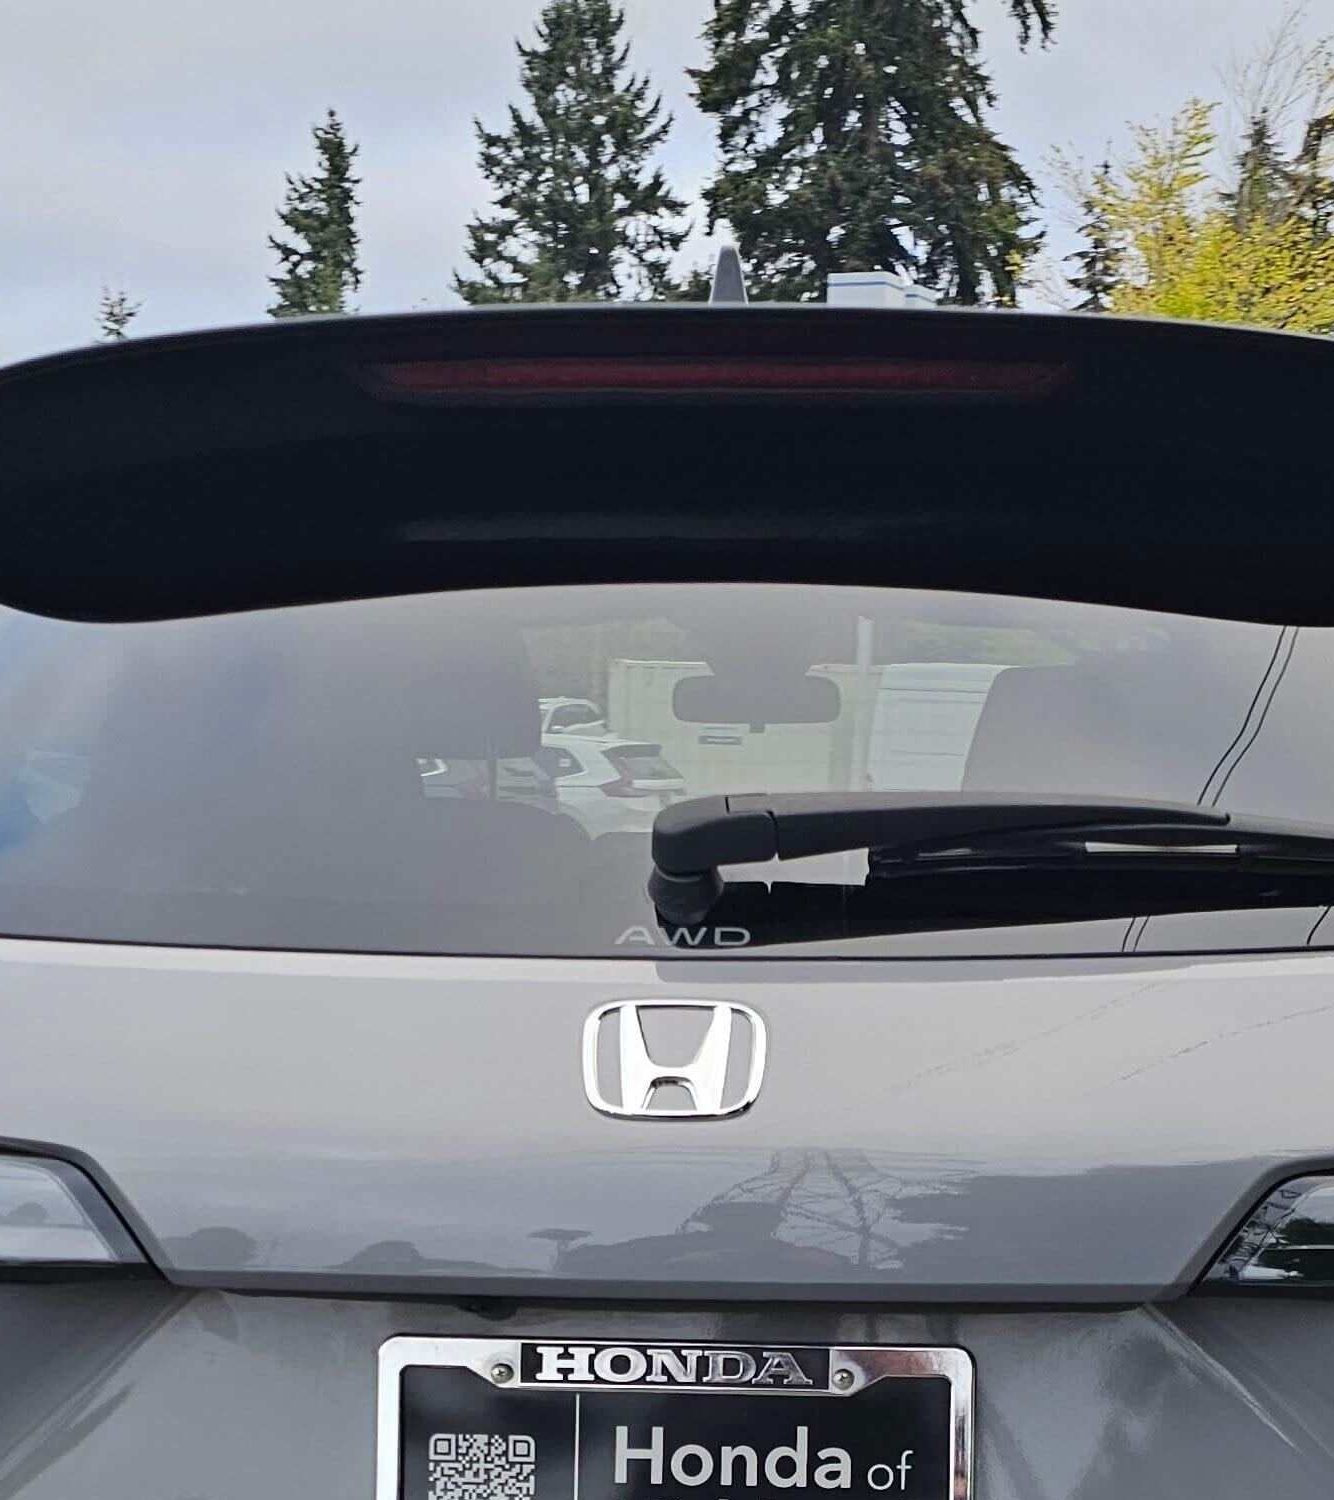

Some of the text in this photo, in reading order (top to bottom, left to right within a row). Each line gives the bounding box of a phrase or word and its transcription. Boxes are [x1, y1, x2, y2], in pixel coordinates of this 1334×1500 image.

[614, 925, 752, 946] AWD
[534, 1345, 814, 1386] HONDA
[613, 1425, 914, 1491] Honda of
